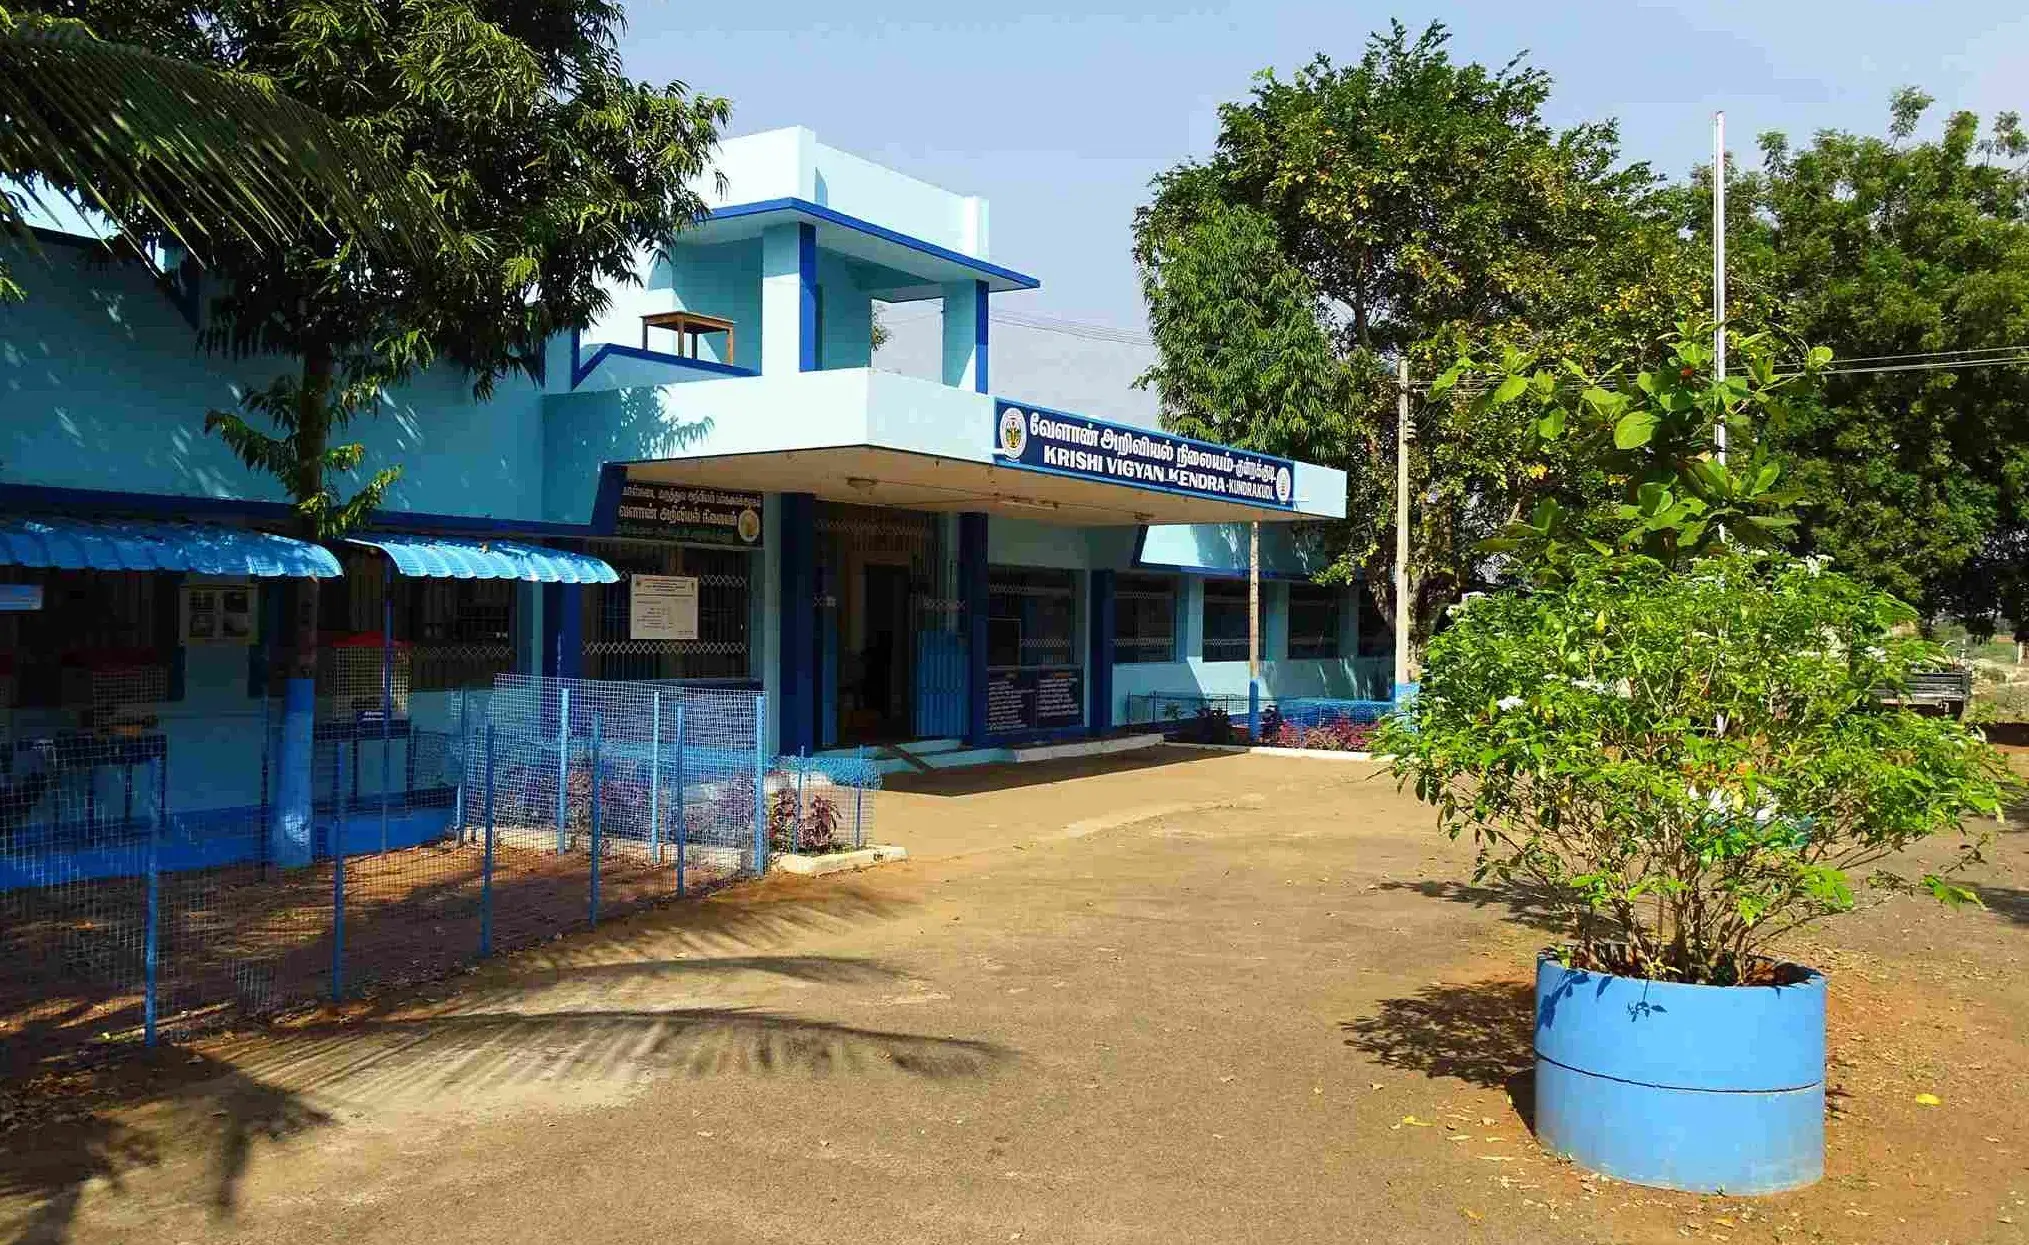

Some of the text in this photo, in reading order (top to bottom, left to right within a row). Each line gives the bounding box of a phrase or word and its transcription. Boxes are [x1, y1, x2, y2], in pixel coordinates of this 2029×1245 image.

[1101, 428, 1173, 461] அறிவியல்
[1044, 446, 1103, 473] KRISHI
[1106, 457, 1164, 483] VIGYAN
